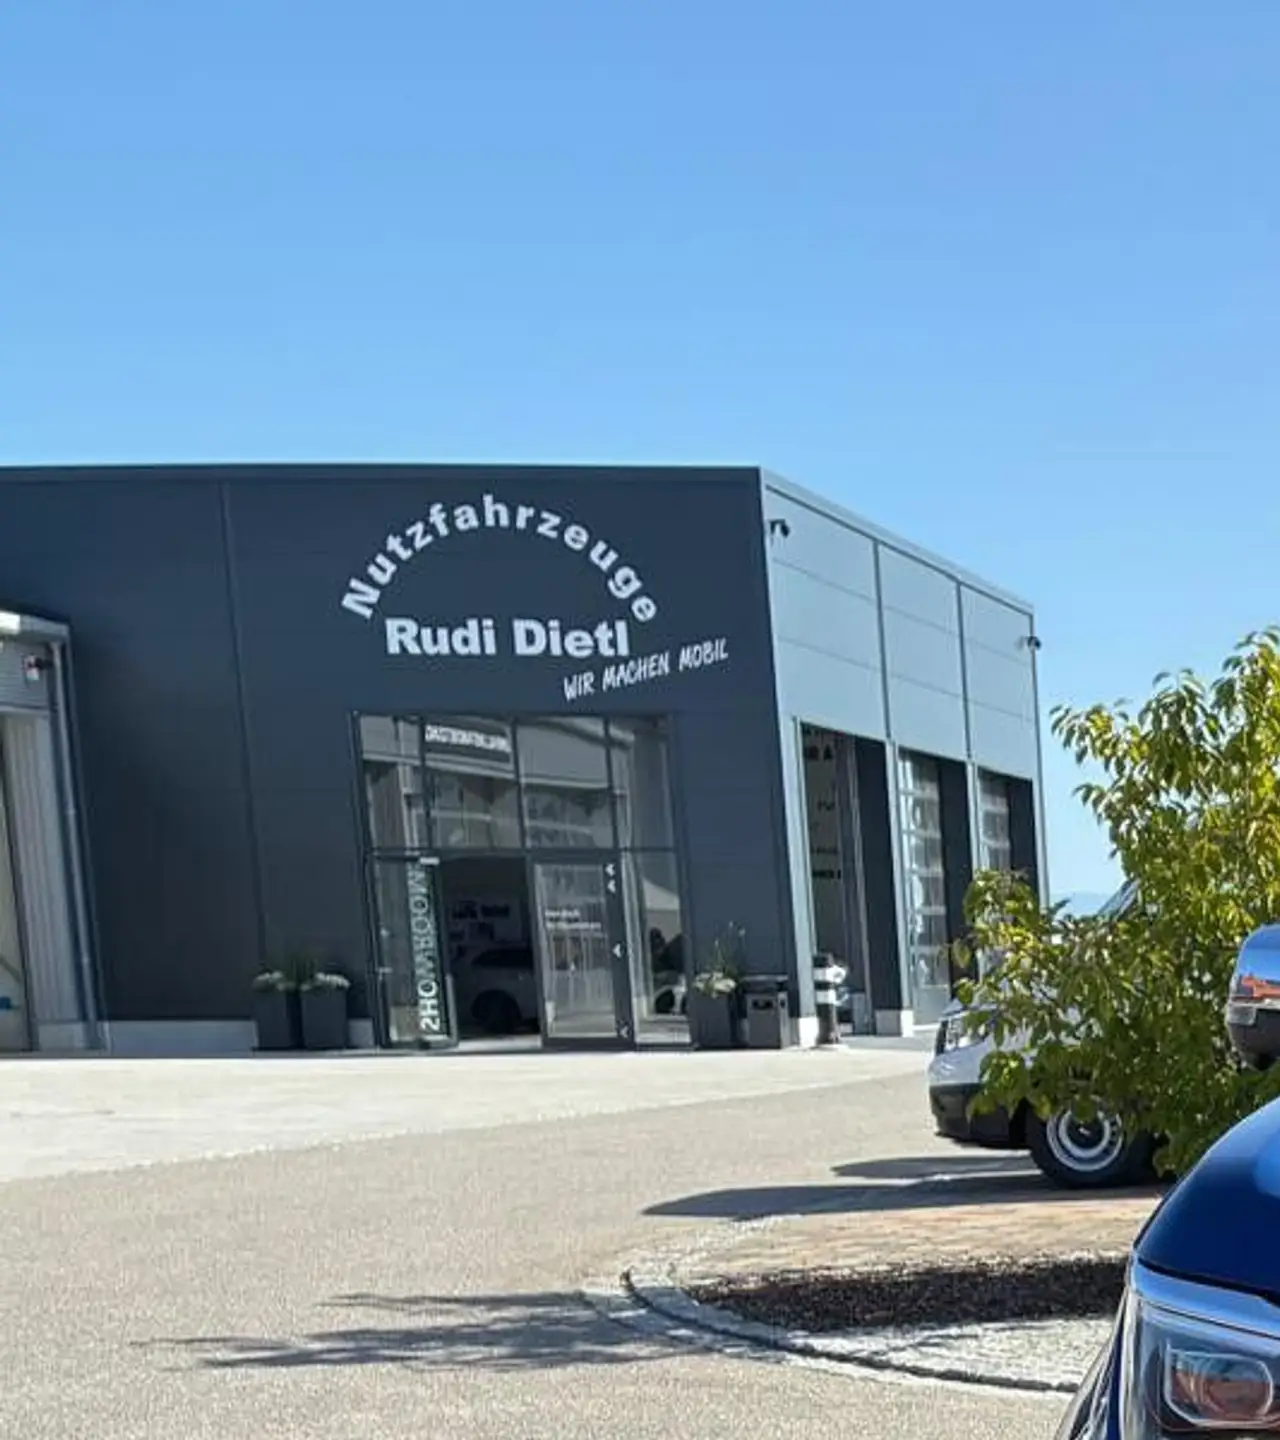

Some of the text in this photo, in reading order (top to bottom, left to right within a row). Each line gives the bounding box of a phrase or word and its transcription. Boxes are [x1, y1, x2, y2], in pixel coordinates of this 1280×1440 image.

[341, 494, 658, 620] Nutzfahrzeuge
[385, 617, 630, 657] Rudi Dietl
[563, 637, 729, 701] WIR MACHEN MOBIL
